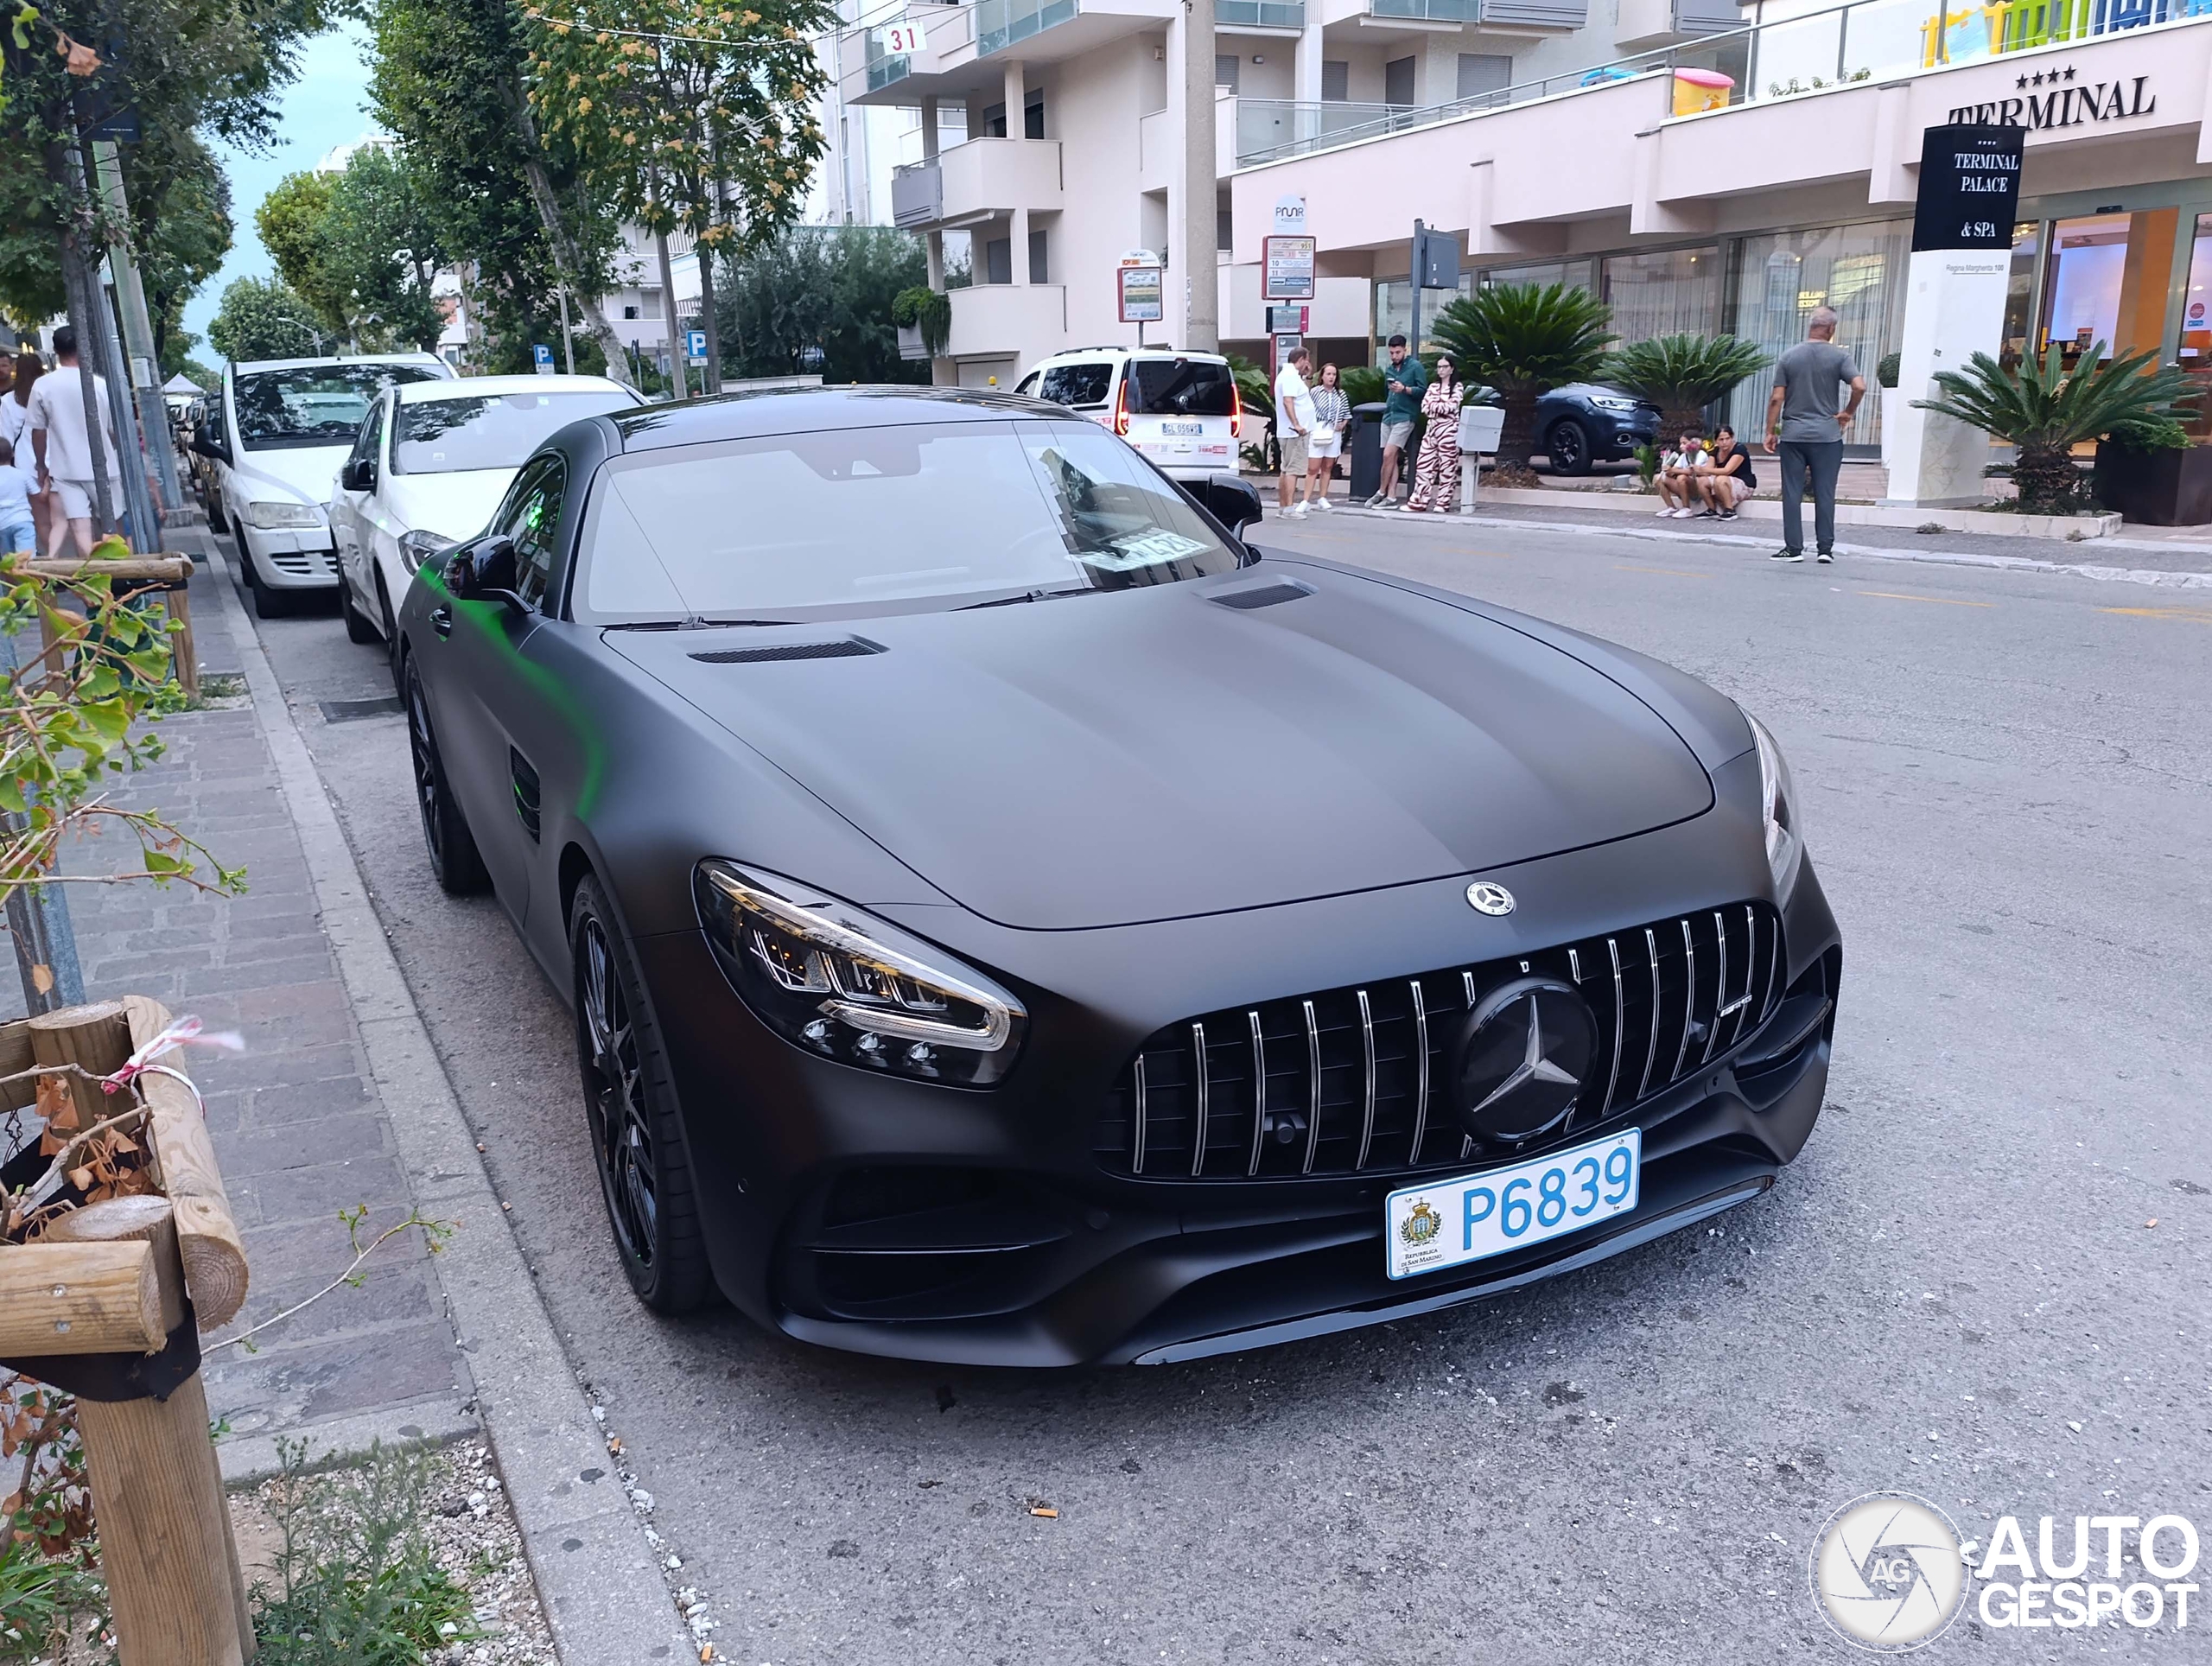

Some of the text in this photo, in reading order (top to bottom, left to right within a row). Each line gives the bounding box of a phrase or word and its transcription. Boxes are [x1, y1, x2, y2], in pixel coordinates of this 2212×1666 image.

[891, 29, 915, 51] 31
[1955, 153, 2019, 170] TERMINAL
[1961, 176, 2008, 193] PALACE
[1961, 221, 1996, 238] & SPA
[692, 333, 706, 355] P
[537, 347, 550, 362] P
[1463, 1146, 1632, 1250] P6839
